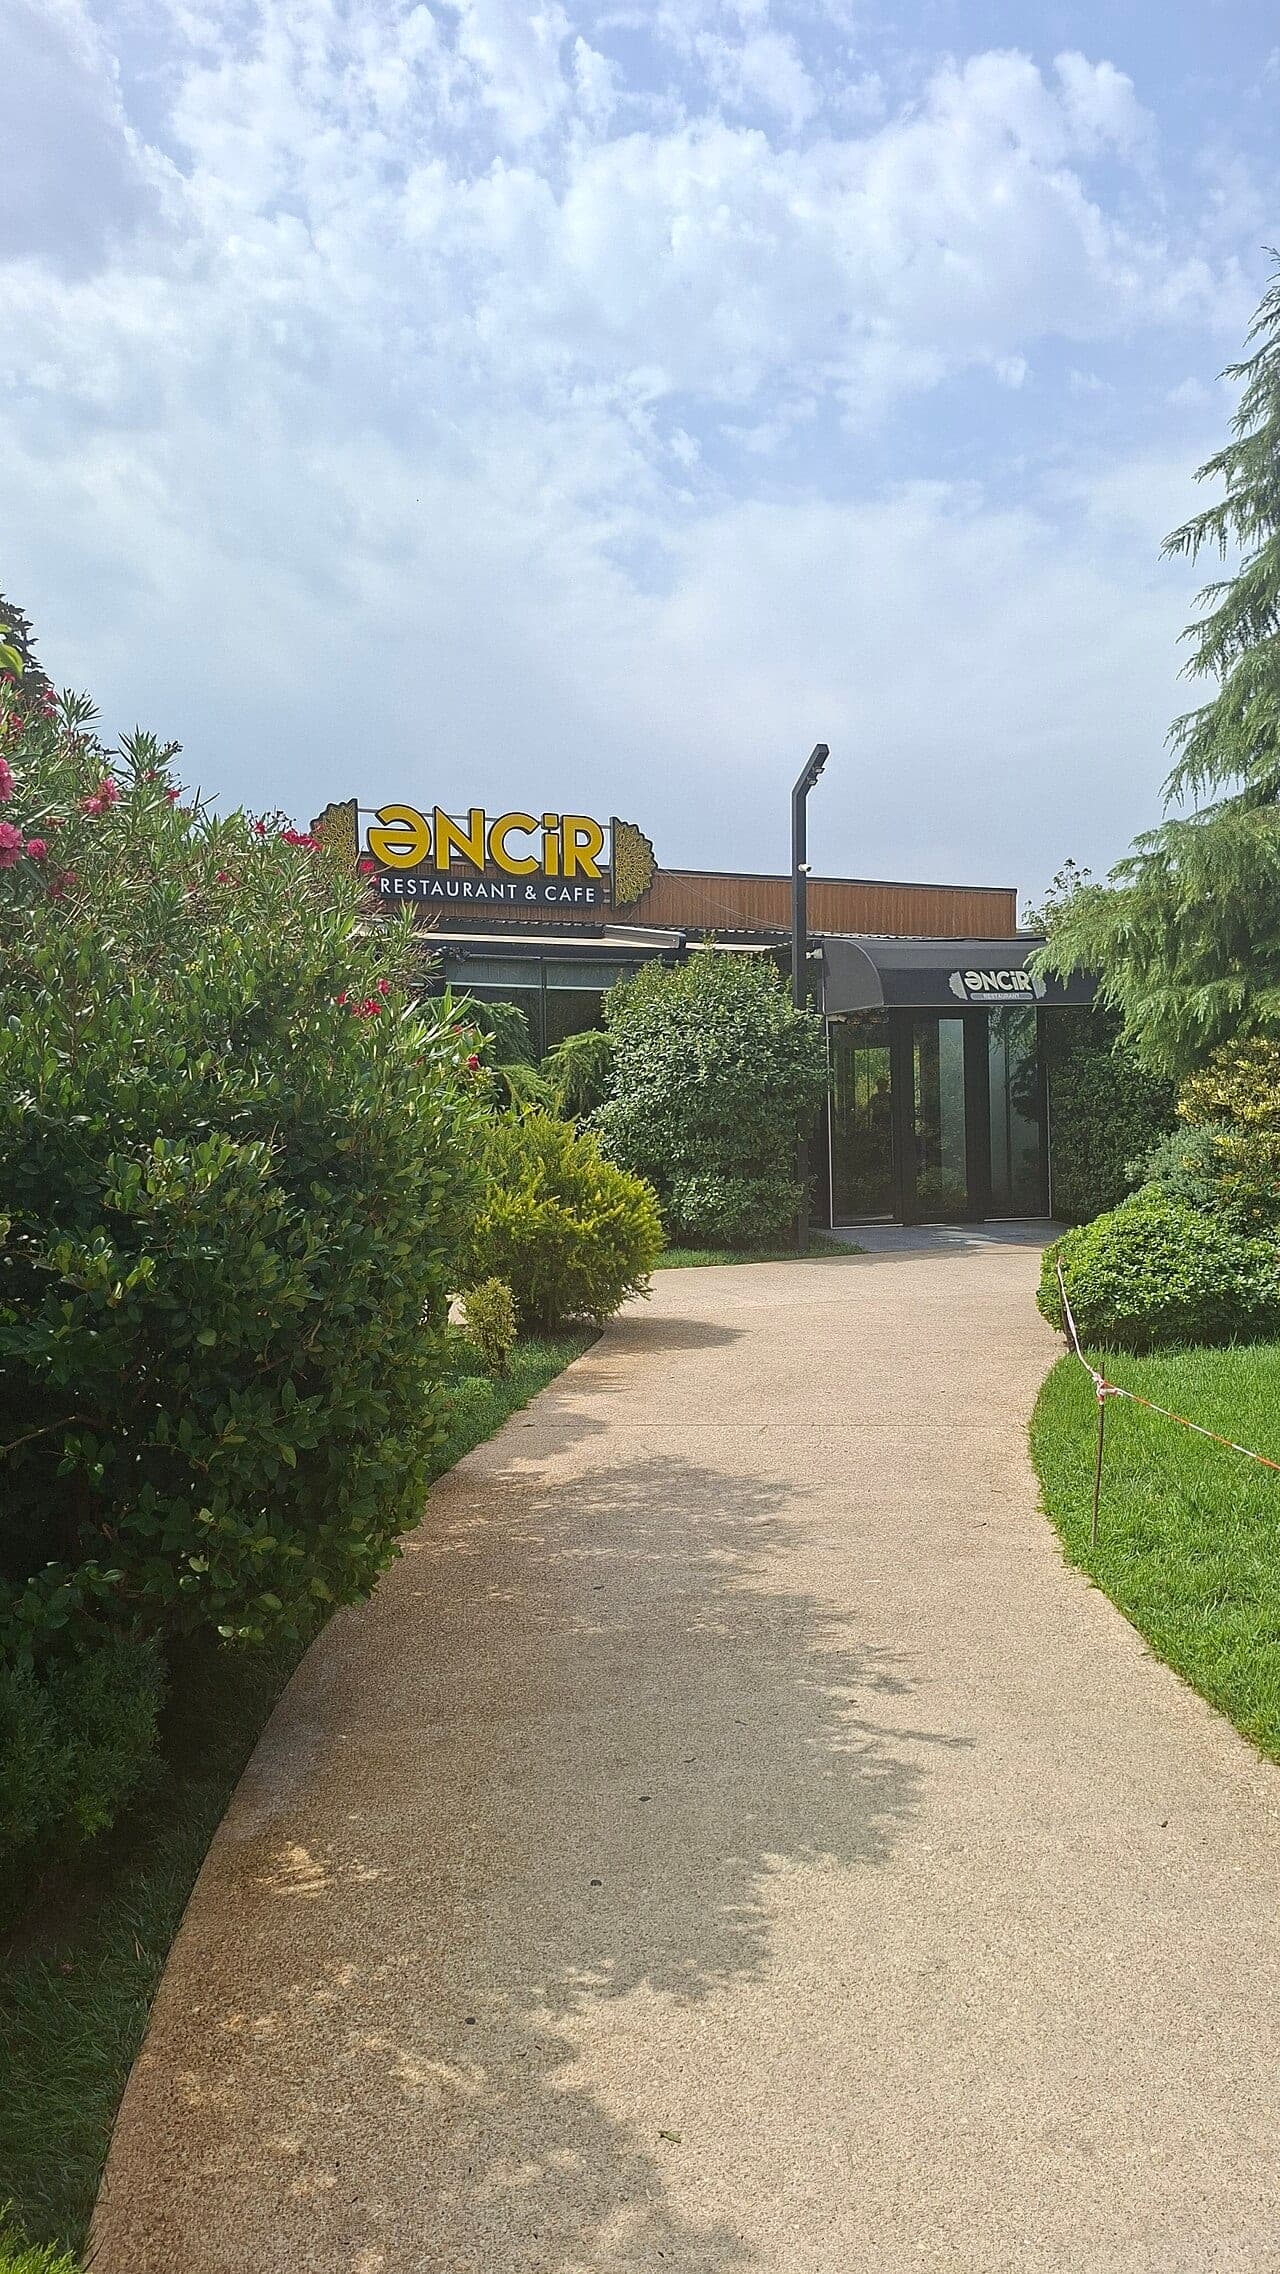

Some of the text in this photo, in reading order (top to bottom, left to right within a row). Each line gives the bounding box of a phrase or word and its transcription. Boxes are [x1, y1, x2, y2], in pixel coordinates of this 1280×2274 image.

[380, 878, 596, 902] RESTAURANT & CAFE
